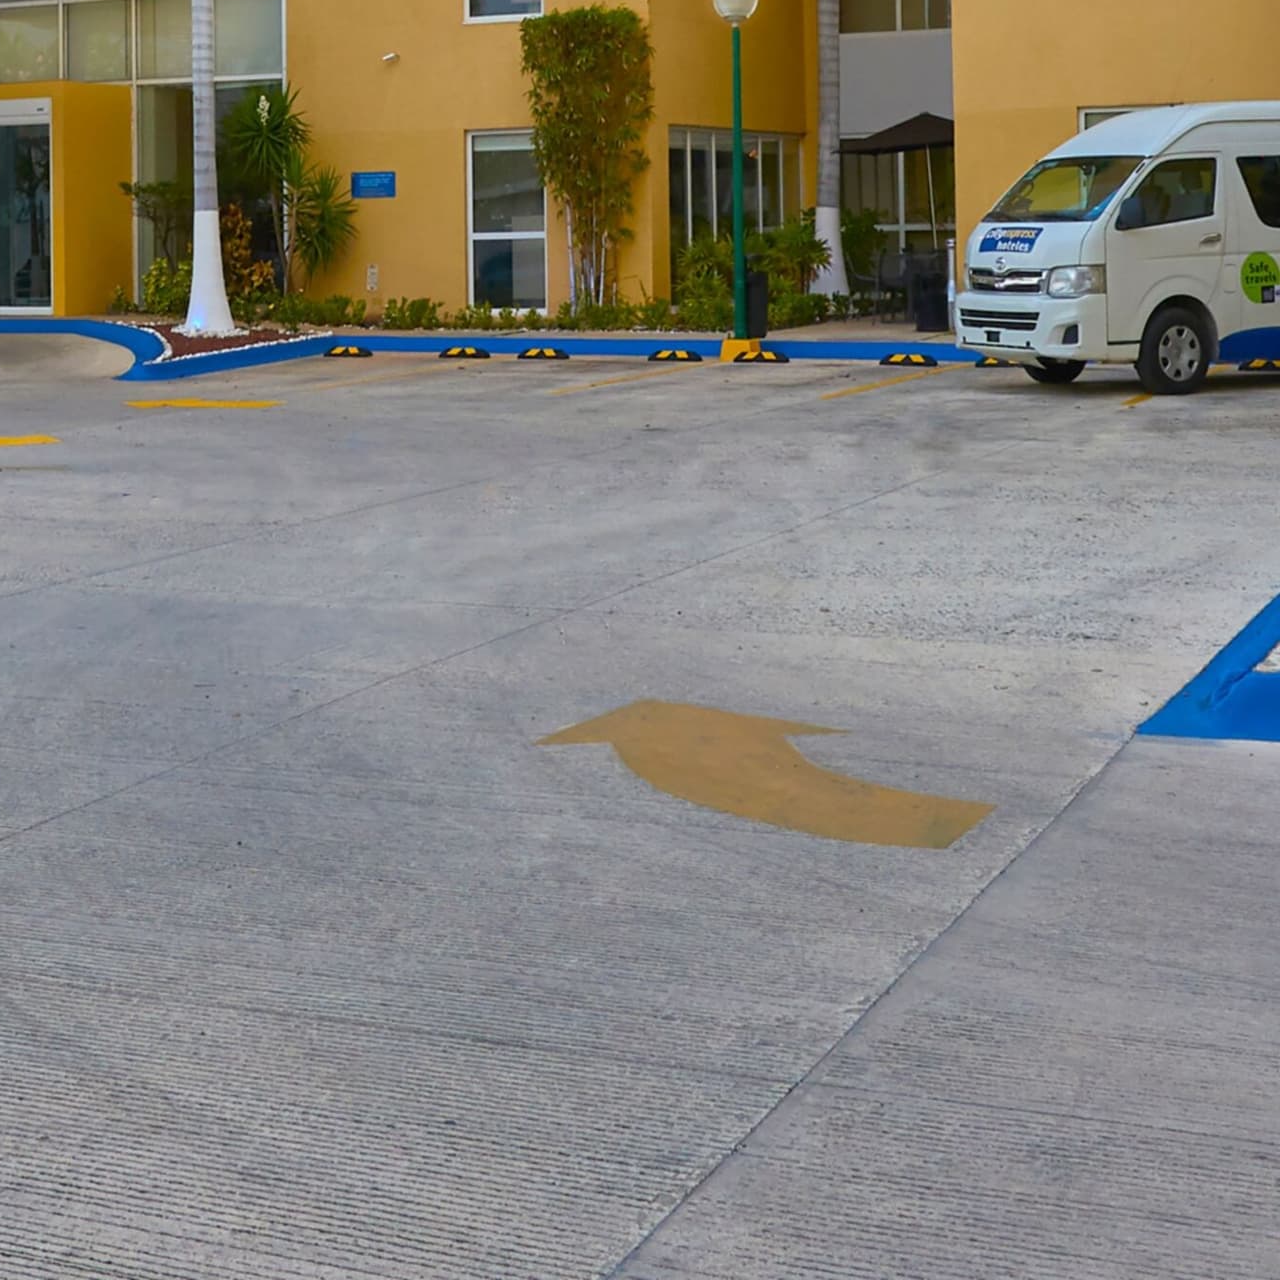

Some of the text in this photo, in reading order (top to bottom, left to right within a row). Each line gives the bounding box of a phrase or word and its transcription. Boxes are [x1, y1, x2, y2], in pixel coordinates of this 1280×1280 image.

[996, 240, 1030, 252] hoteles
[1249, 261, 1270, 274] Safe
[1245, 271, 1277, 285] travels
